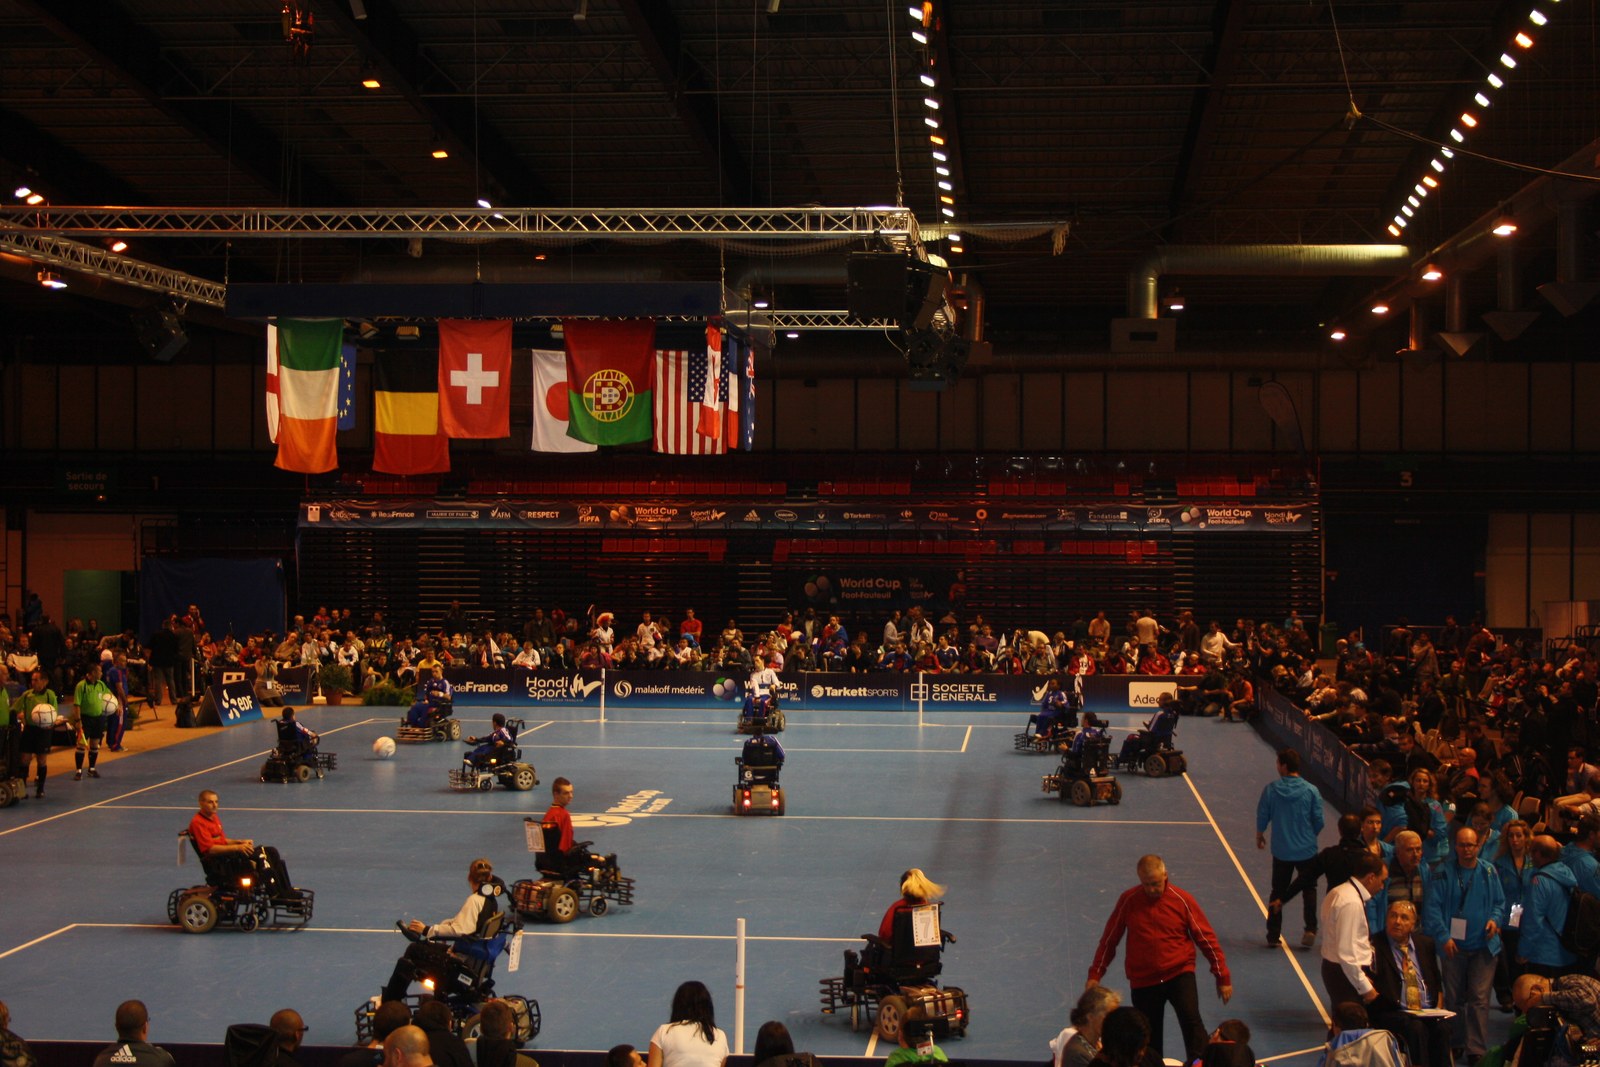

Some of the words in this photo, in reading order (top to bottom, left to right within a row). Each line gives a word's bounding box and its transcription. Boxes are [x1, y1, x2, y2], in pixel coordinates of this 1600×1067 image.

[66, 471, 94, 481] Sortie
[96, 471, 108, 481] de
[1400, 471, 1412, 487] 3
[68, 482, 105, 491] secours
[660, 507, 678, 516] Cup
[1206, 508, 1231, 517] World
[1232, 508, 1252, 518] Cup
[840, 577, 874, 588] World
[875, 577, 901, 590] Cup
[526, 676, 569, 688] Handi
[528, 687, 568, 700] Sport
[634, 684, 670, 694] malakoff
[671, 684, 704, 694] médéric
[932, 684, 985, 693] SOCIETE
[932, 693, 997, 702] GENERALE
[1134, 694, 1161, 705] Adec
[110, 1055, 137, 1063] adidas
